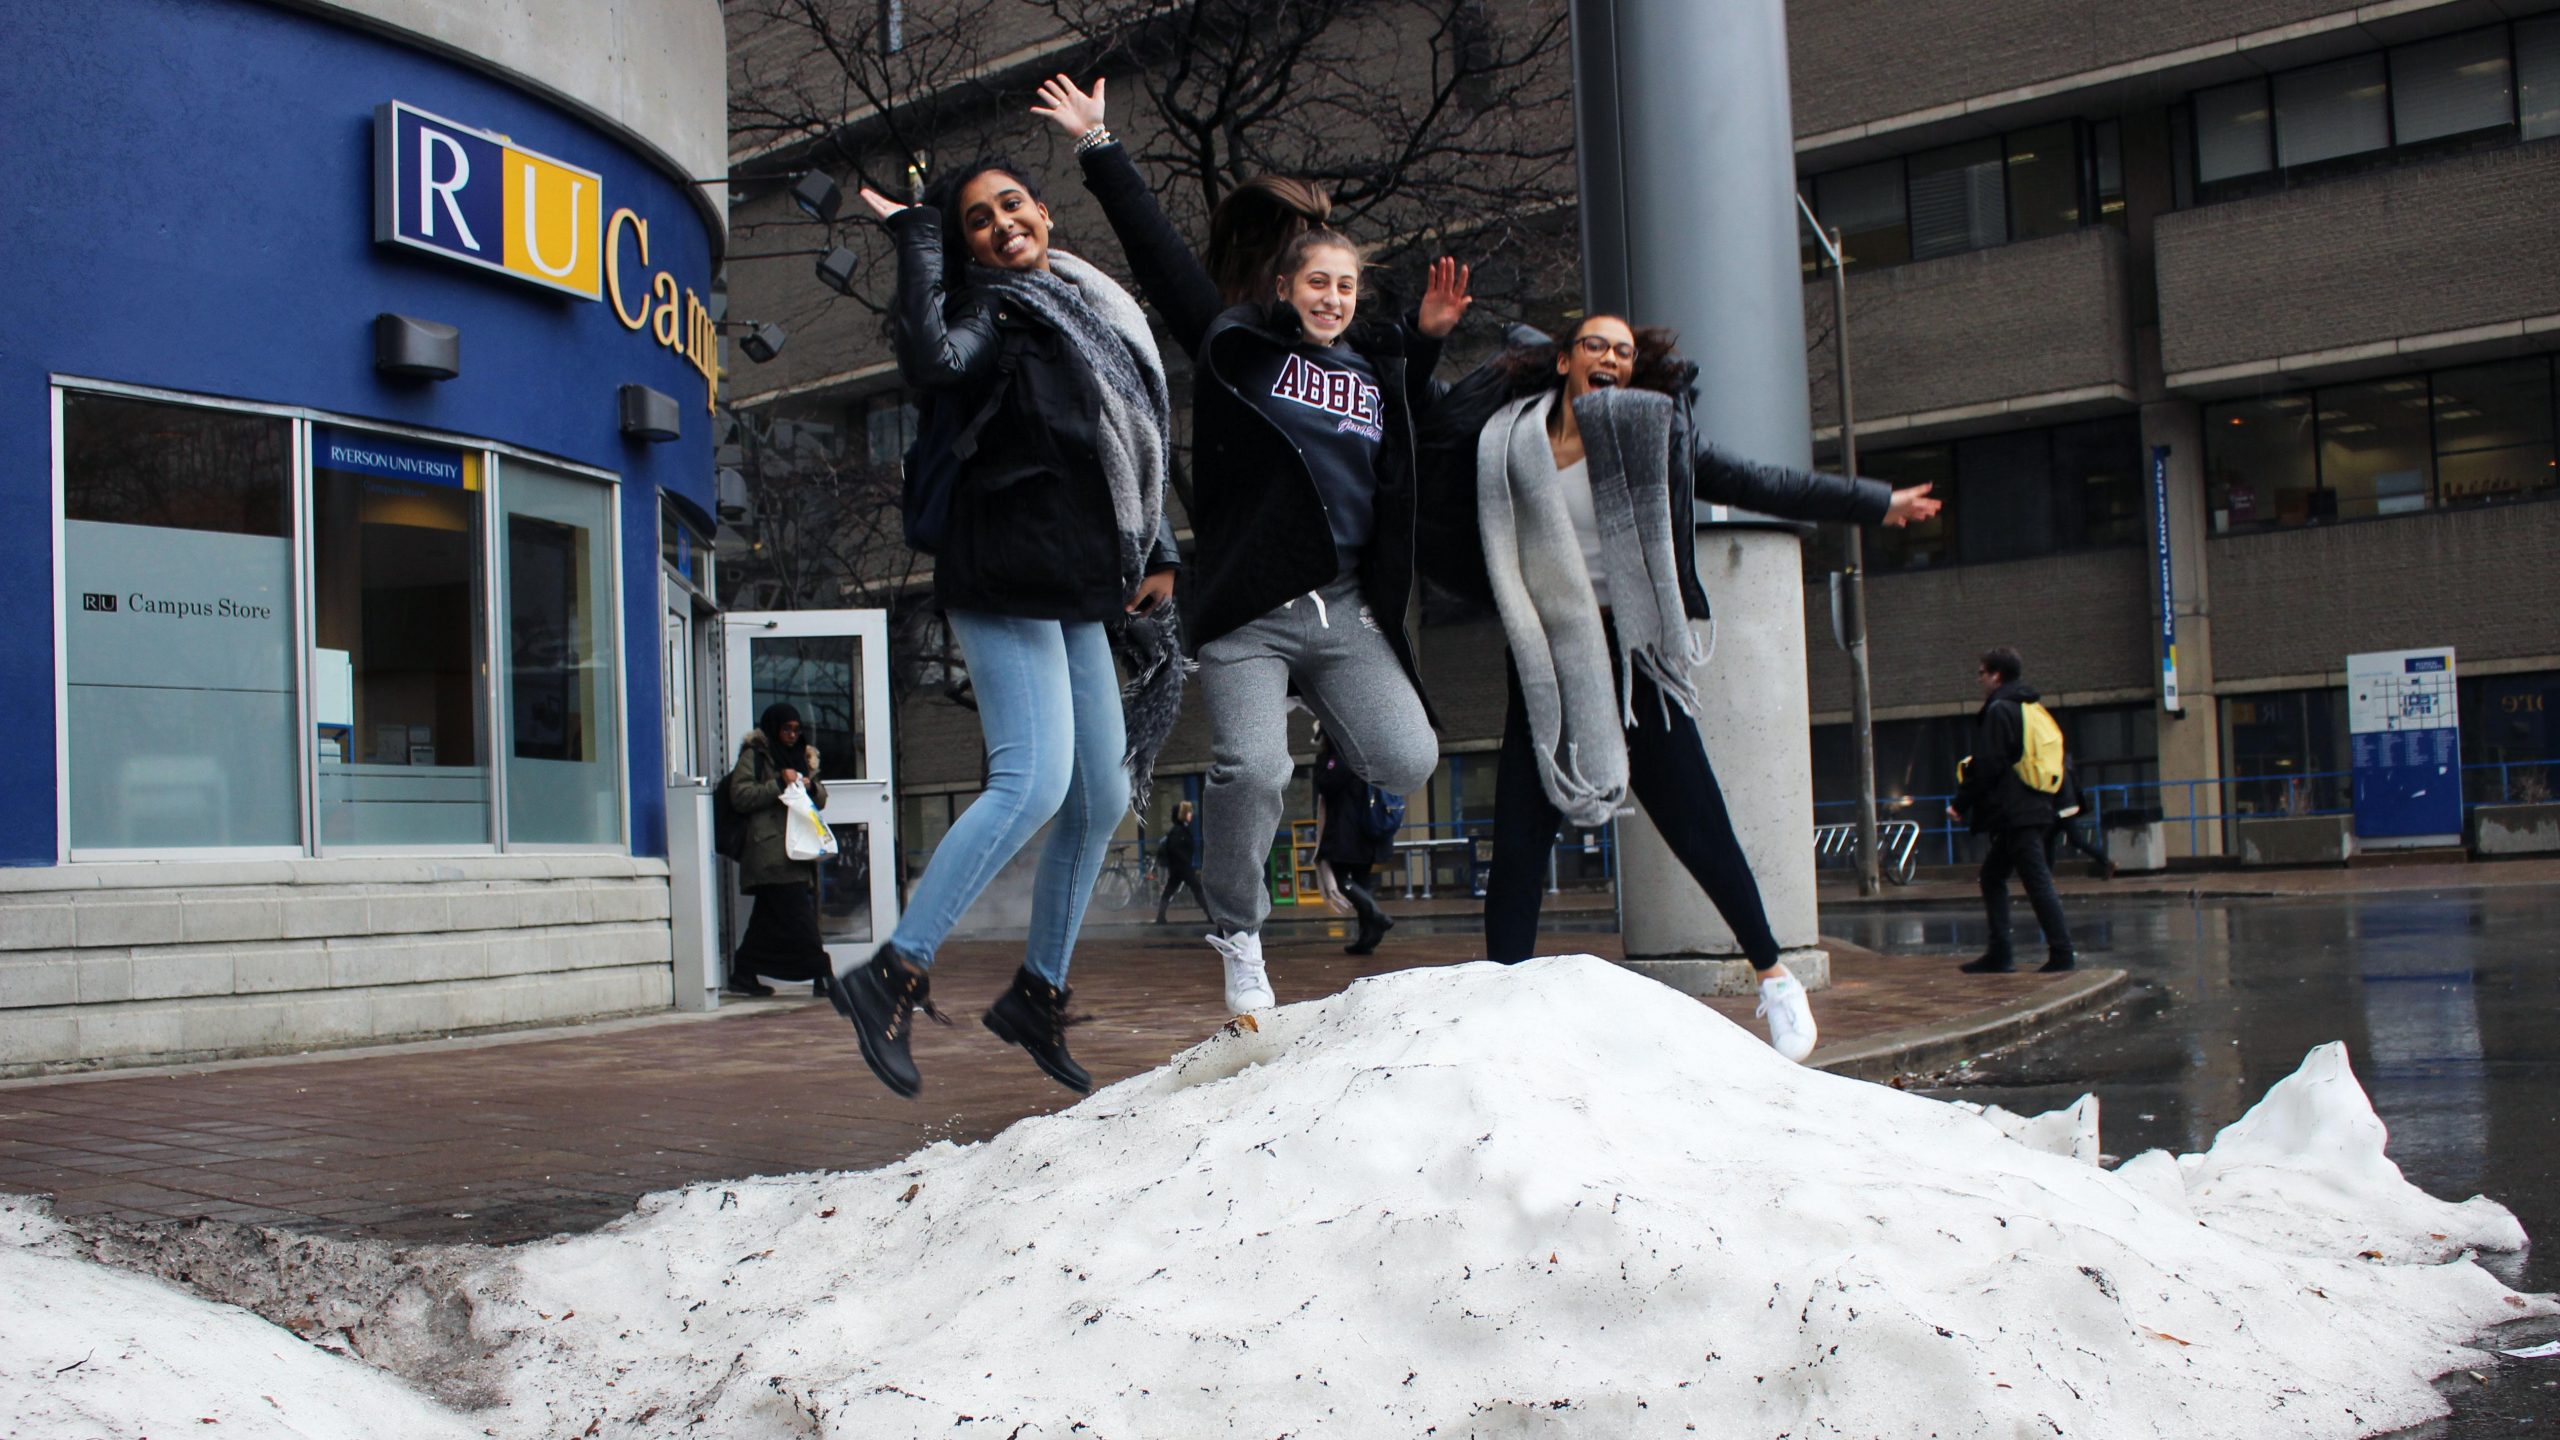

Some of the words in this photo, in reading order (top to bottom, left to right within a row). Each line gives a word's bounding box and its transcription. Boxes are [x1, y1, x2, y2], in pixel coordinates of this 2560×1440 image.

[331, 445, 389, 469] RYERSON
[389, 455, 458, 479] UNIVERSITY
[2156, 459, 2168, 554] University
[84, 595, 116, 611] RU
[128, 593, 213, 618] Campus
[218, 598, 271, 619] Store
[2162, 558, 2173, 636] Ryerson
